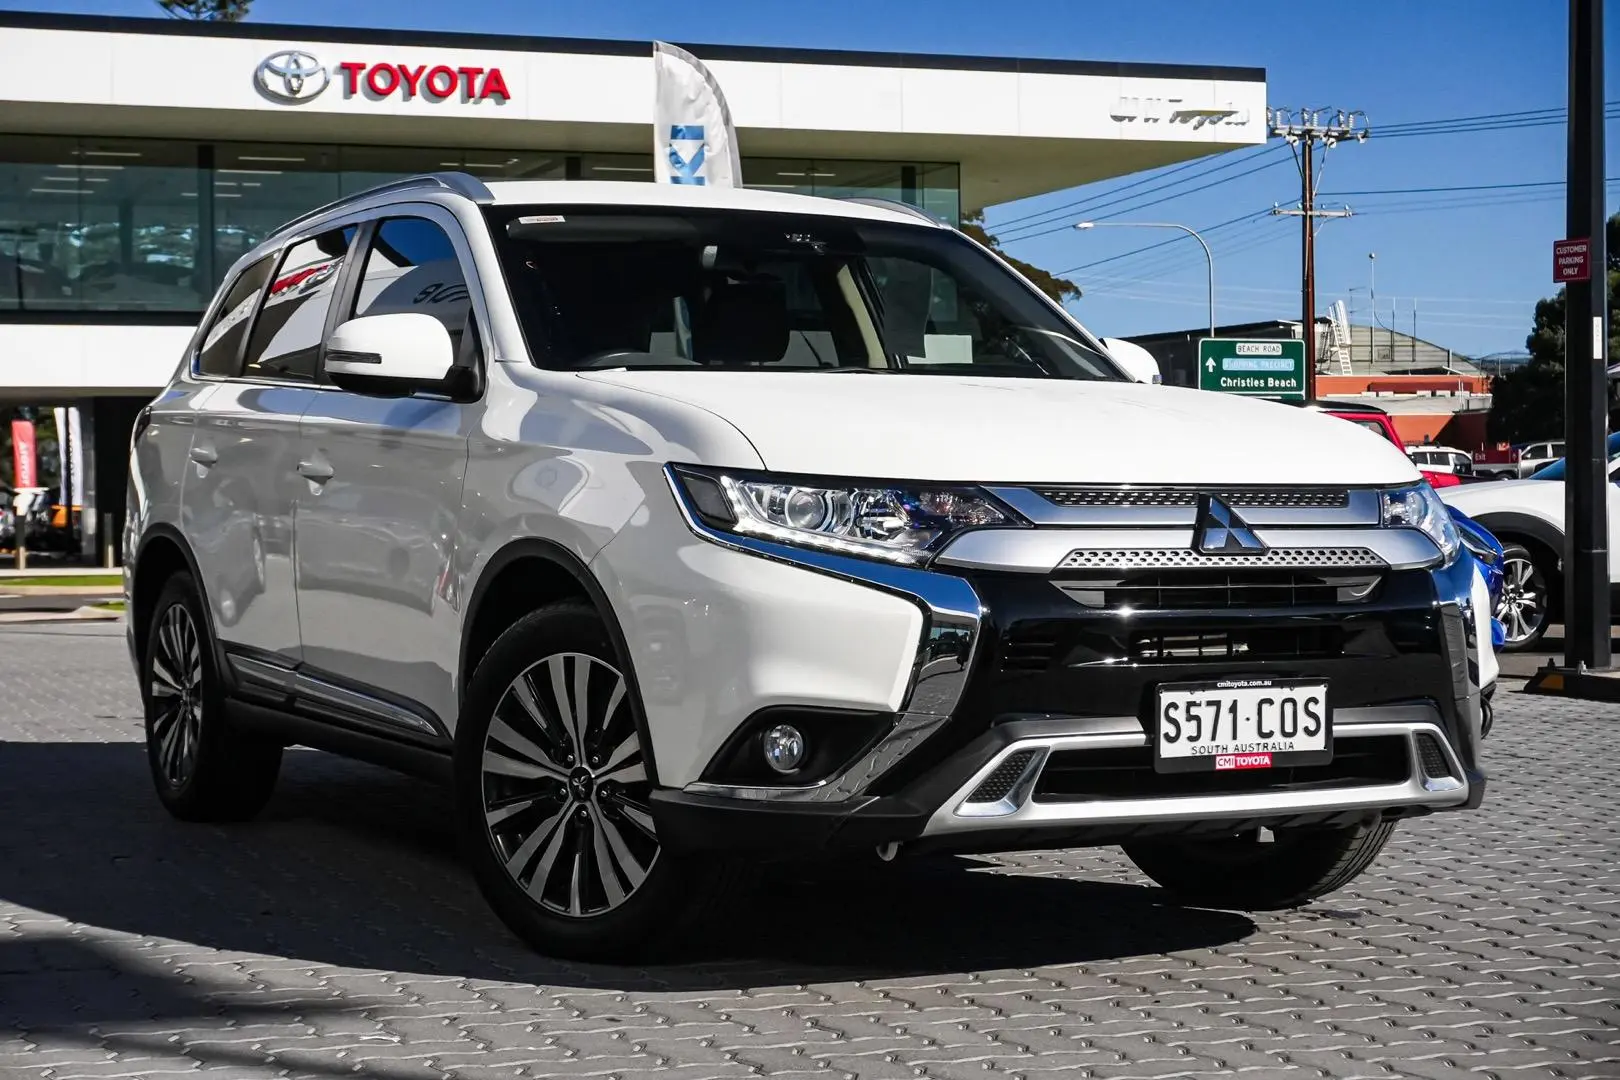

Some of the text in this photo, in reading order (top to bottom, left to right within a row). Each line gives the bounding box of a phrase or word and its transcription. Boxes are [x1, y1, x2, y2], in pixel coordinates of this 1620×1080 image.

[340, 62, 511, 100] TOYOTA
[1556, 245, 1587, 254] CUSTOMER
[1558, 256, 1584, 265] PARKING
[1563, 267, 1578, 275] ONLY
[1237, 345, 1281, 353] BEACH ROAD
[1220, 377, 1297, 388] Christies Beach
[1474, 453, 1486, 461] Exit
[1191, 741, 1295, 755] SOUTH AUSTRALIA
[1217, 755, 1271, 767] CMI TOYOTA
